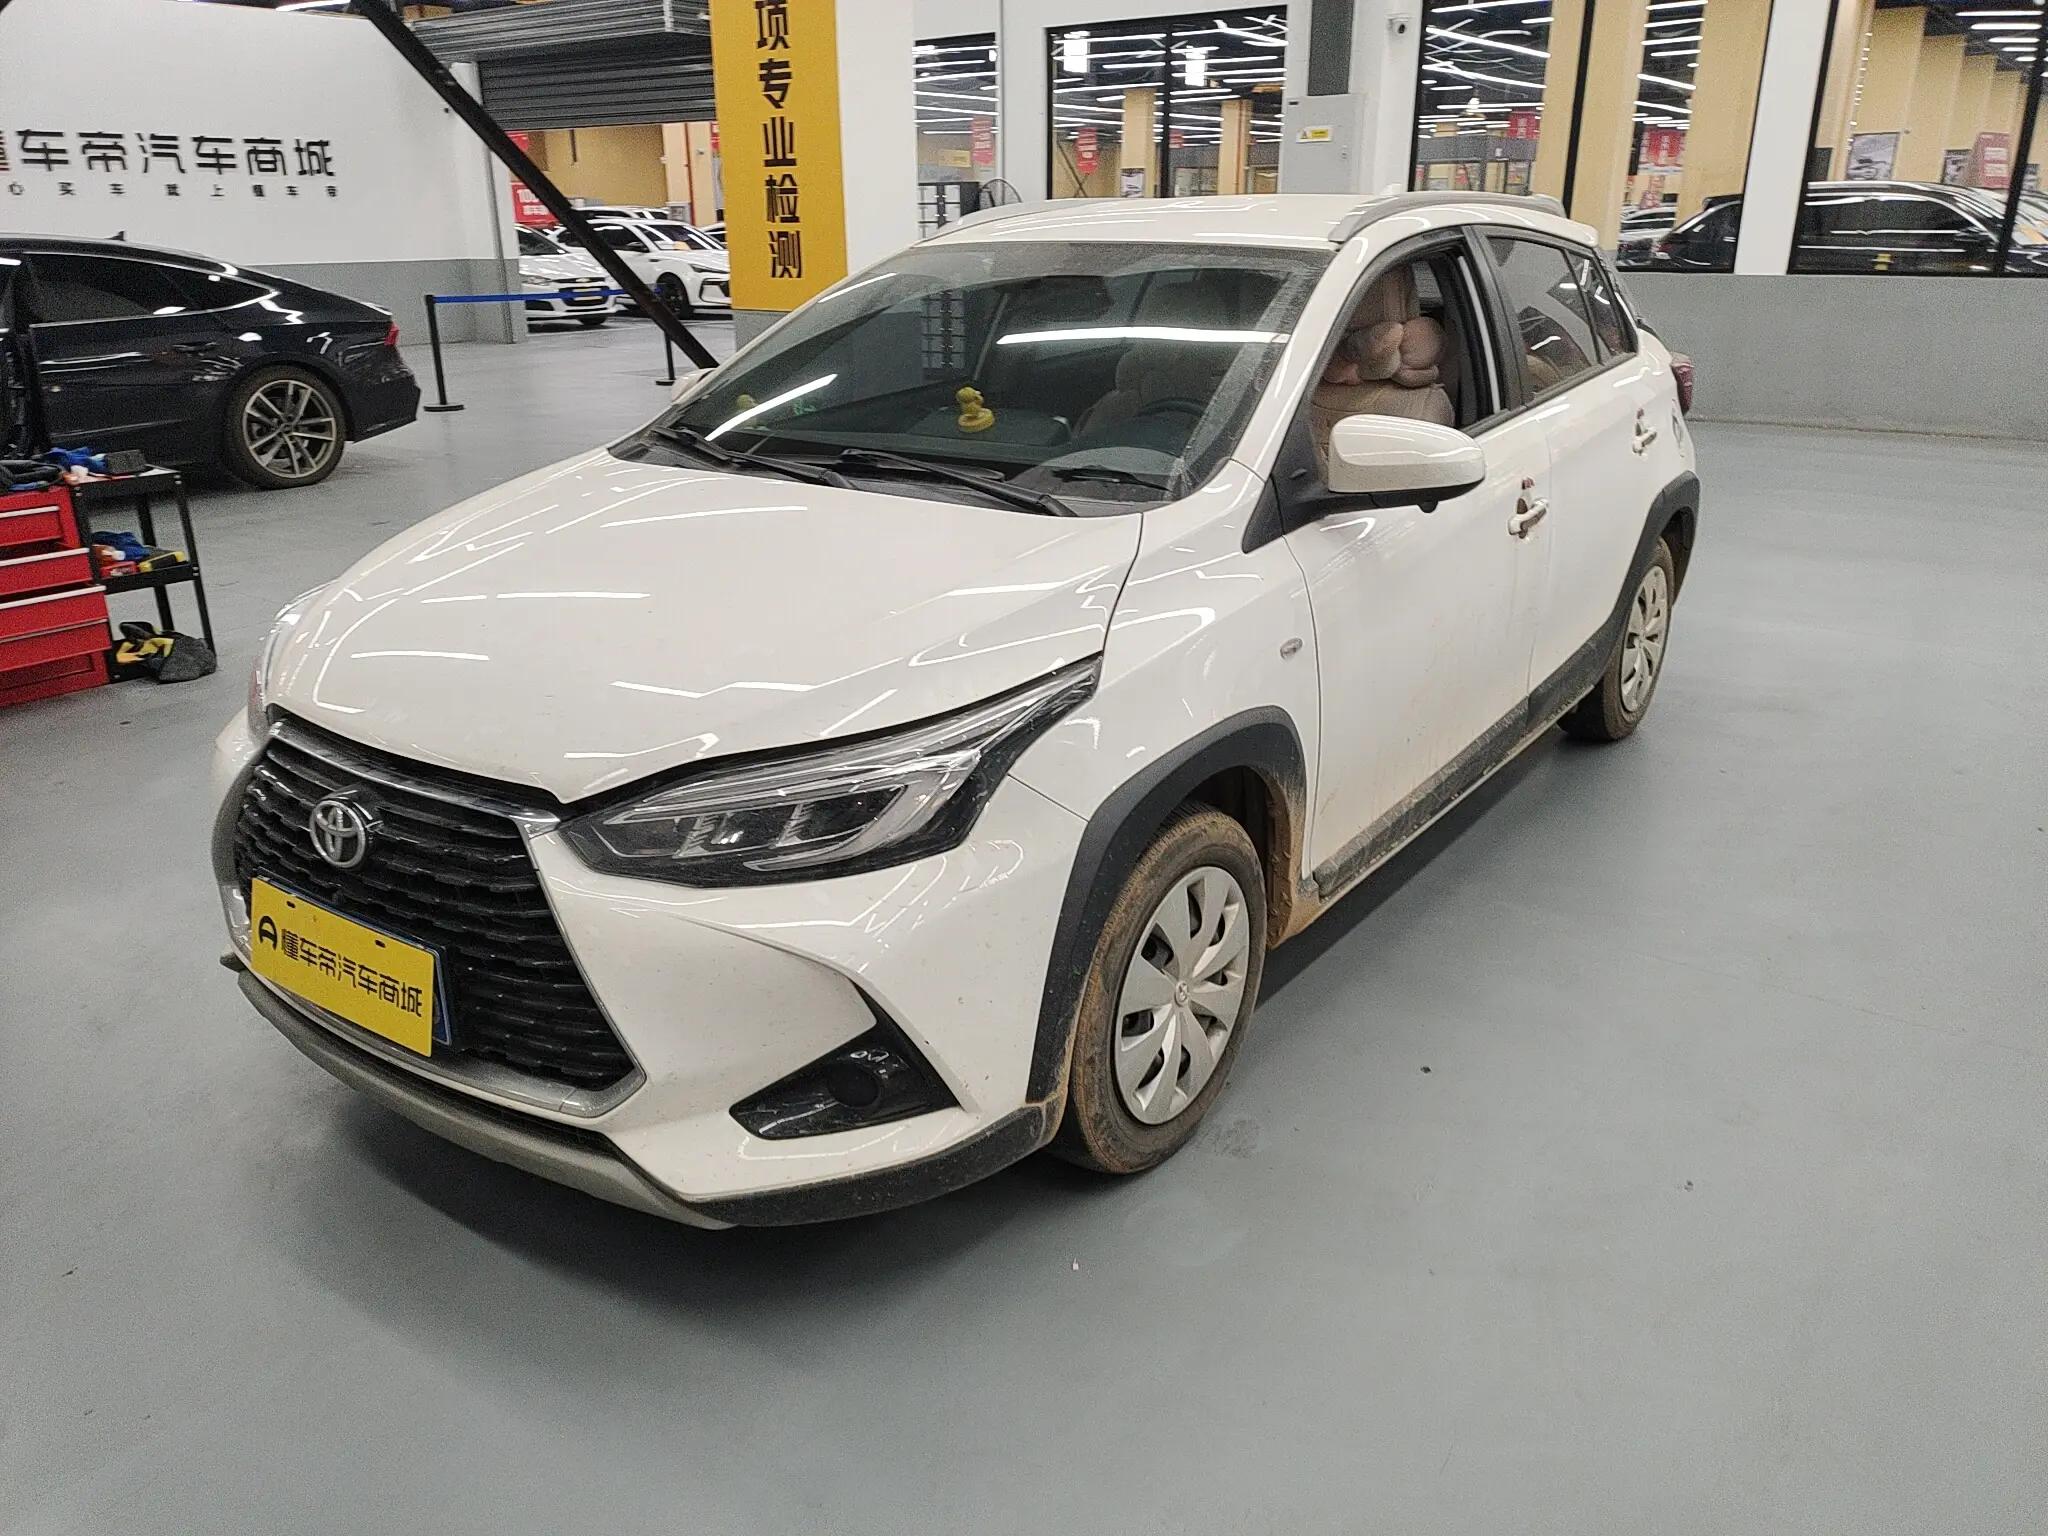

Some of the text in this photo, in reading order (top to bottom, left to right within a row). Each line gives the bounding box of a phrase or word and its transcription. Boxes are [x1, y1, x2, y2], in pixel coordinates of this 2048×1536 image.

[0, 129, 335, 176] 车帝汽车商城
[754, 0, 803, 278] 项专业检测
[282, 928, 422, 1017] 懂车帝汽车商城
